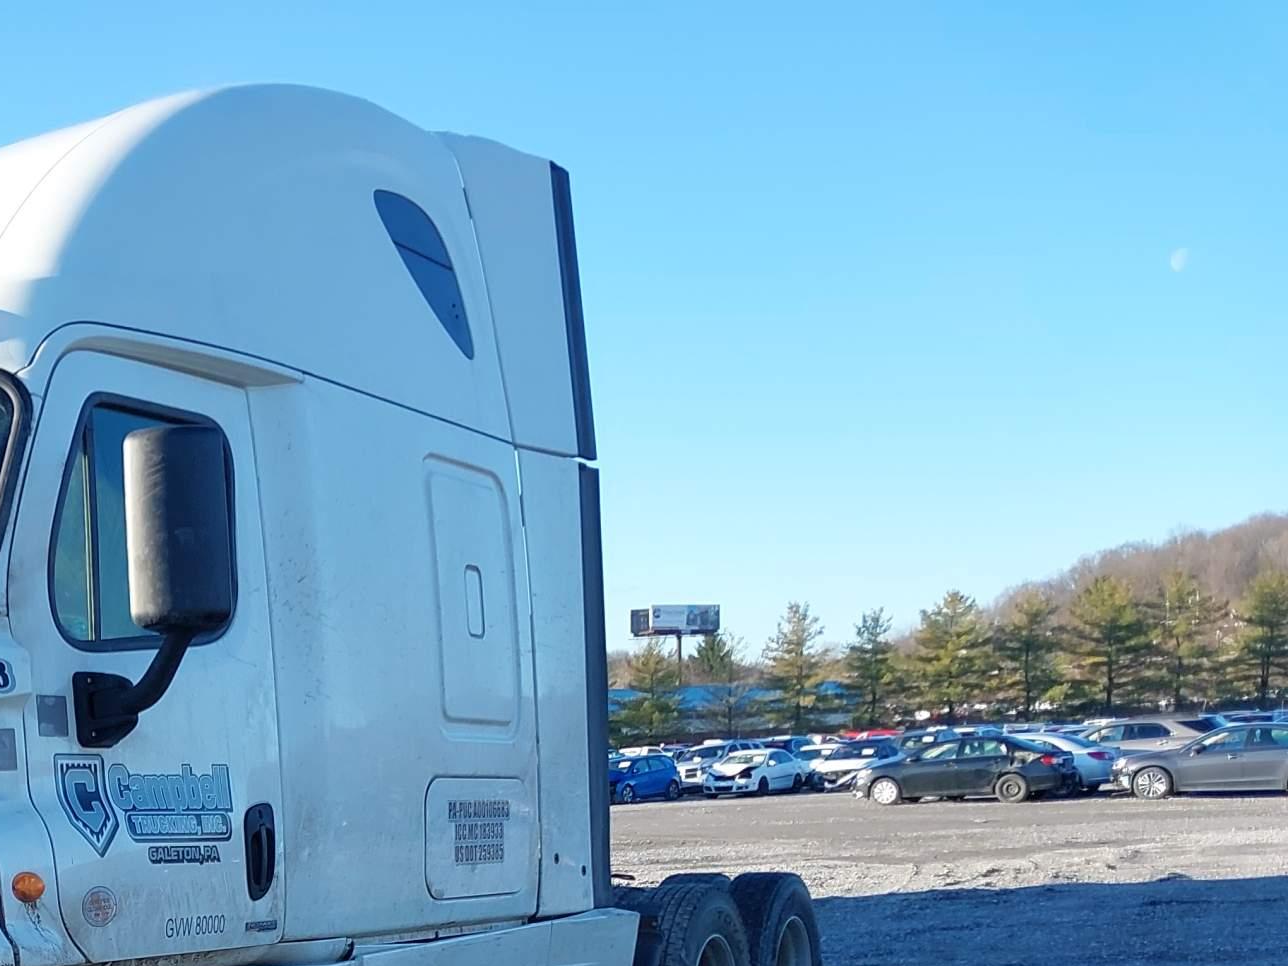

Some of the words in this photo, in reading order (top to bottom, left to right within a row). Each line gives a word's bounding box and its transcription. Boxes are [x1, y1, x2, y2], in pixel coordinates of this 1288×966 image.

[109, 764, 232, 813] Campbell
[131, 815, 202, 835] TRUCKING,
[455, 823, 467, 841] ICC
[467, 823, 478, 840] MC
[455, 845, 464, 863] US
[464, 844, 478, 862] DOT
[165, 916, 193, 938] GVW
[195, 914, 225, 935] 80000
